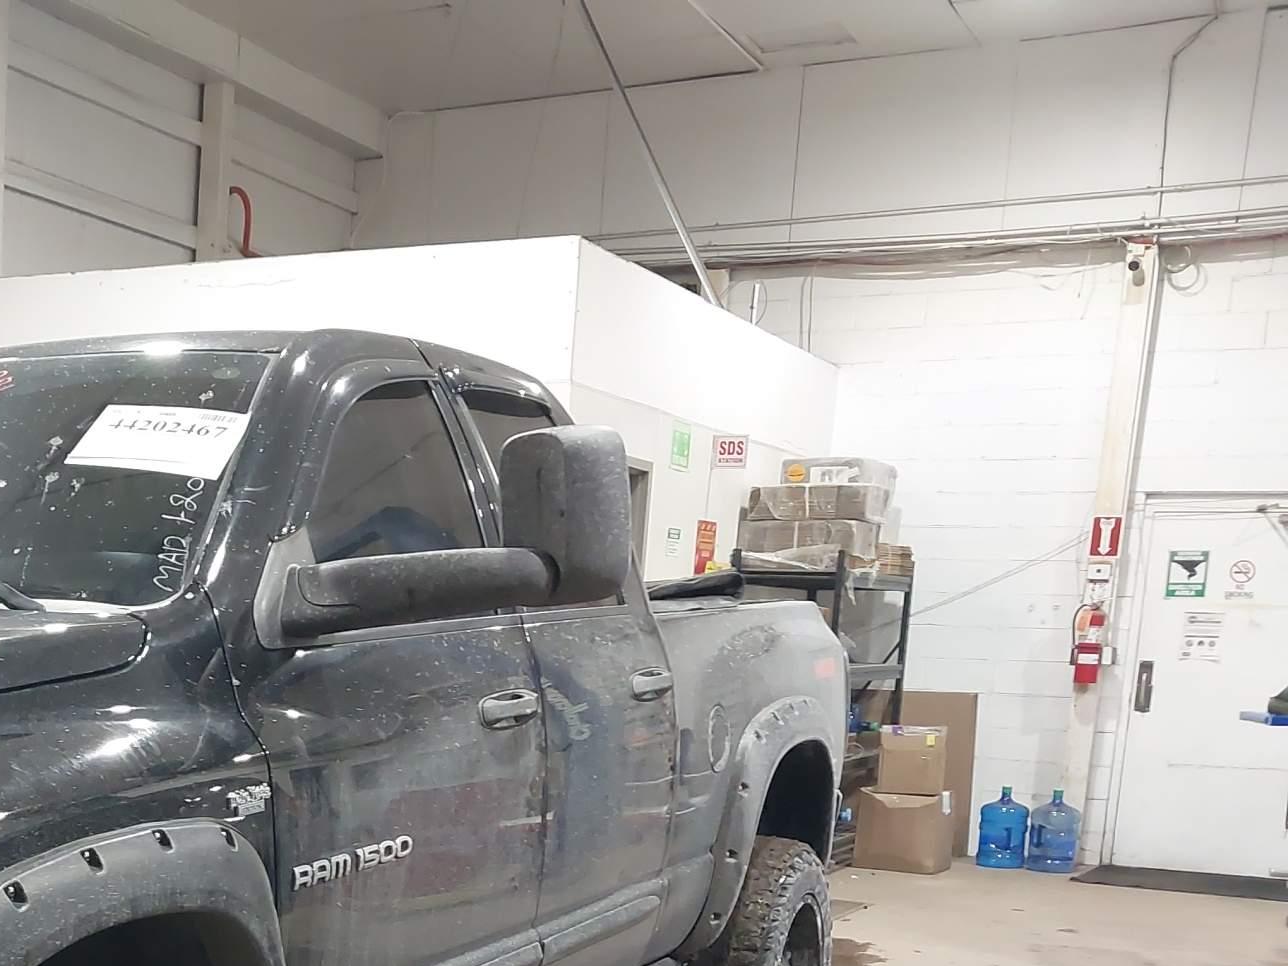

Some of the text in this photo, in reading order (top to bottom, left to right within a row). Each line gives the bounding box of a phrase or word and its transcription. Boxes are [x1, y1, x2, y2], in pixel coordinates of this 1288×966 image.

[108, 418, 228, 438] 44202467
[718, 440, 744, 456] SDS
[152, 536, 189, 592] MAD
[292, 834, 414, 891] RAM 1500
